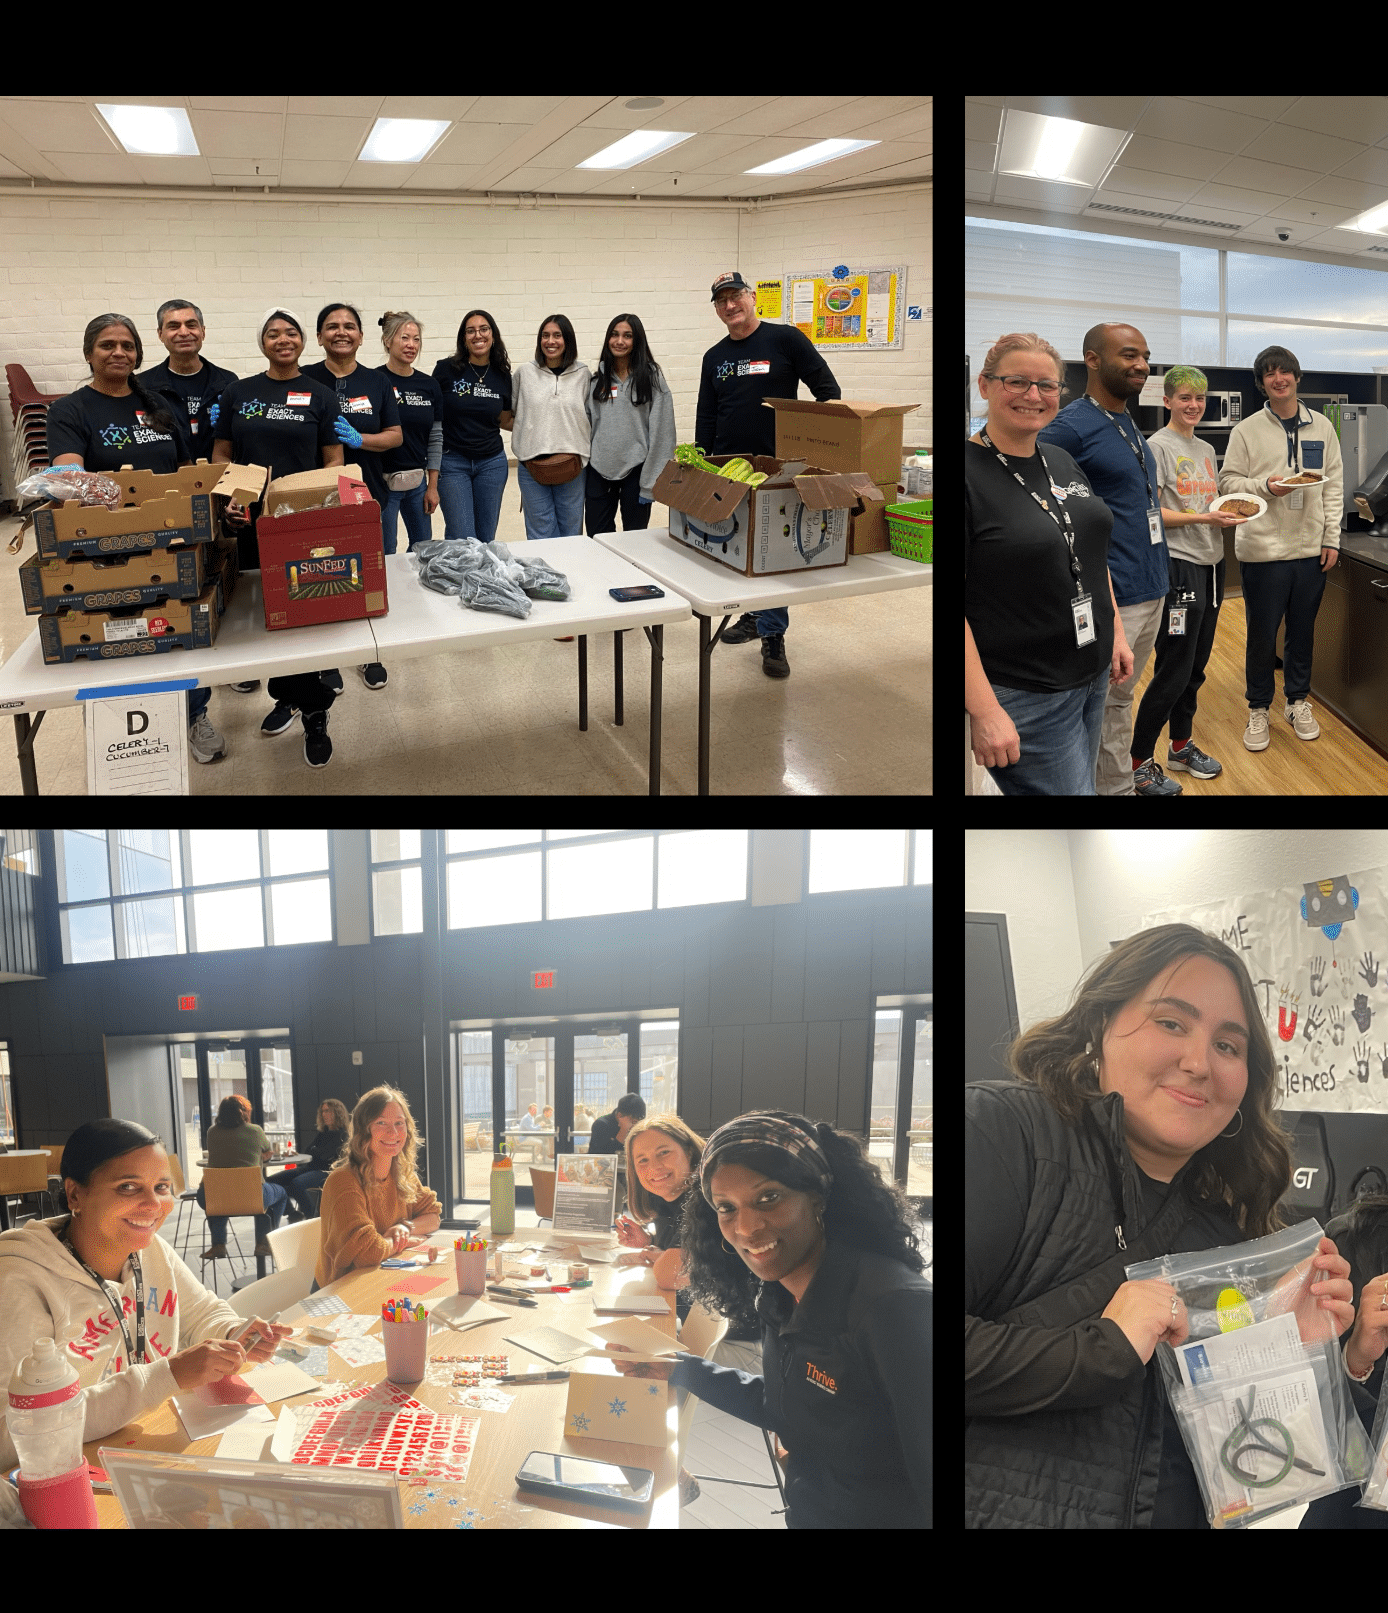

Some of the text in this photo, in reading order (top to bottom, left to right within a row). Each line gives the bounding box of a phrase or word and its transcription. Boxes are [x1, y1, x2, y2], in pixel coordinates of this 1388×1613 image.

[266, 413, 305, 421] SCIENCES
[98, 533, 157, 551] GRAPES
[803, 516, 814, 549] Mayor's
[84, 590, 141, 607] GRAPES
[101, 640, 156, 657] GRAPES
[126, 710, 149, 736] D
[107, 738, 149, 753] CELERY
[535, 972, 553, 988] EXIT
[1278, 1055, 1336, 1098] iences
[1293, 1167, 1319, 1190] GT
[68, 1287, 178, 1361] AMERIAN
[806, 1361, 838, 1390] Thrive.
